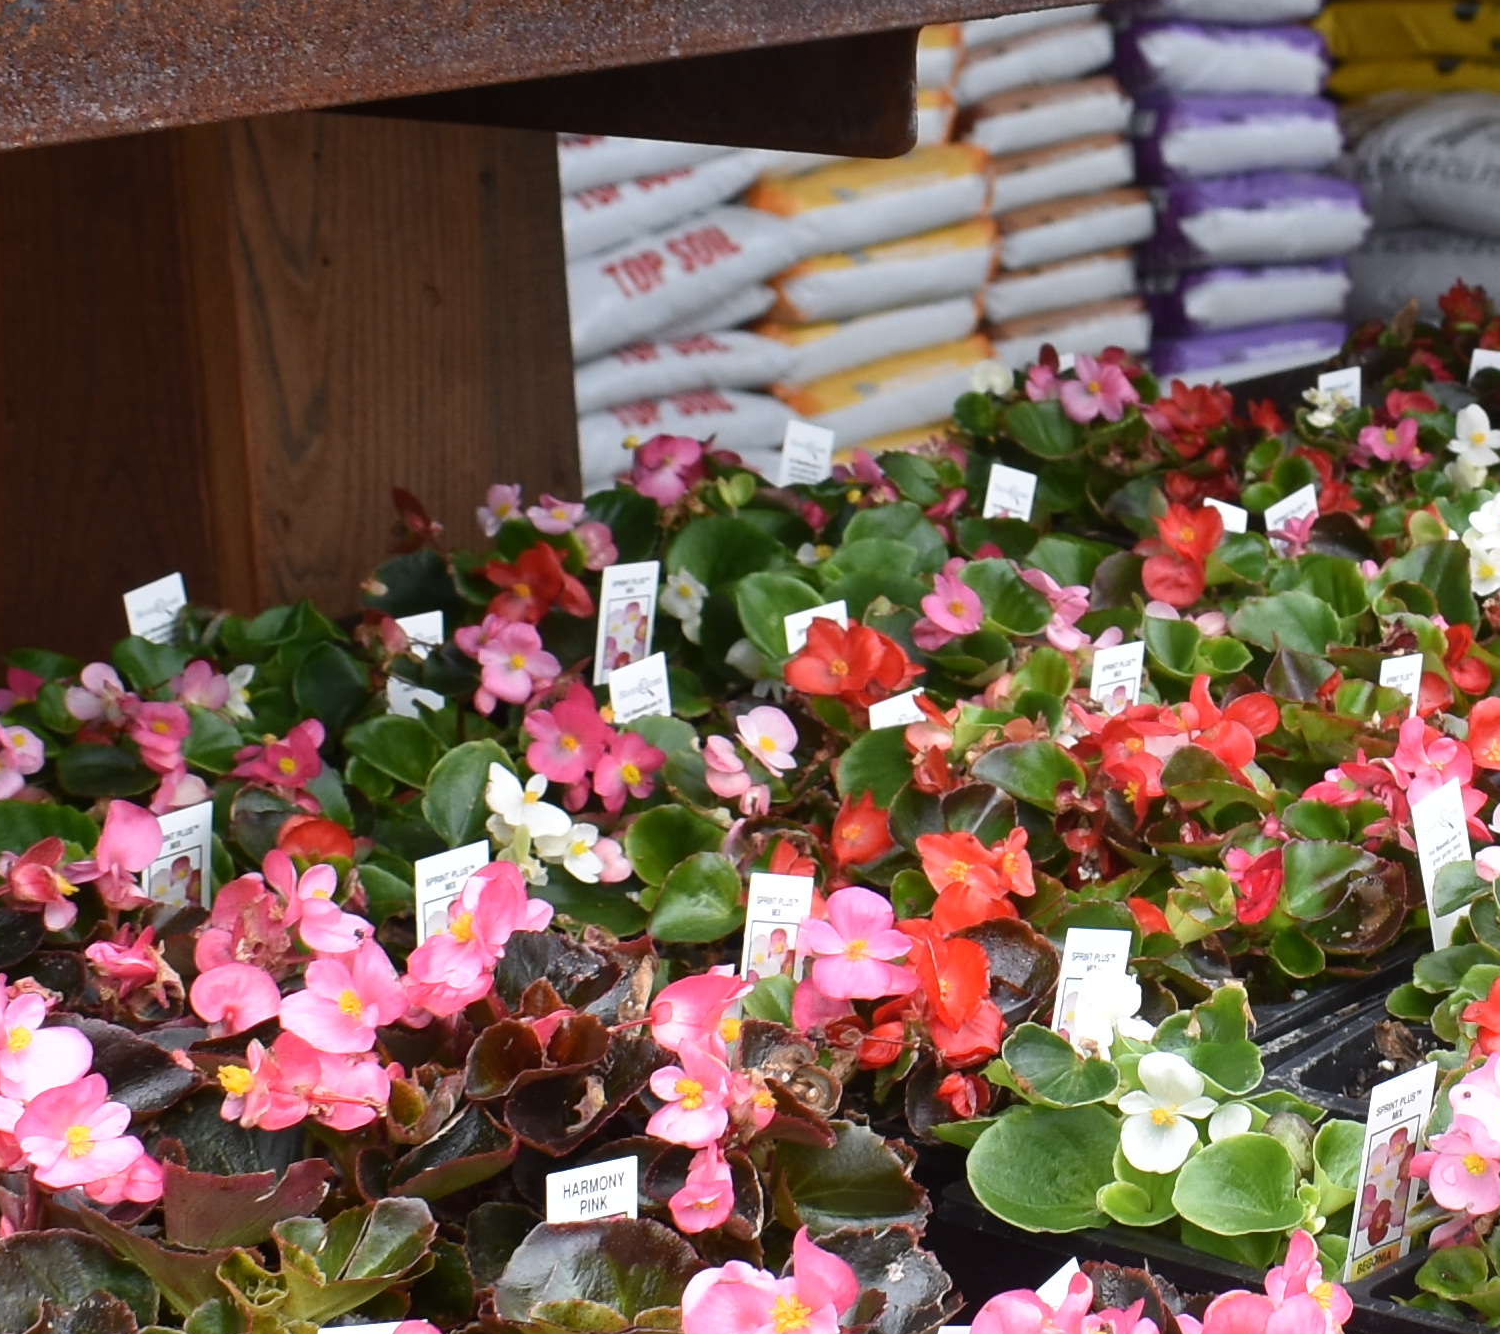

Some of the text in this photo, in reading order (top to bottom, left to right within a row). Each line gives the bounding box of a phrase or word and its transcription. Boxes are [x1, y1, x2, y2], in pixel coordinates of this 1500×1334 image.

[601, 226, 743, 301] TOP SOIL
[1376, 1099, 1399, 1117] SPRINT
[1391, 1108, 1403, 1121] MIX
[562, 1172, 625, 1199] HARMONY
[579, 1195, 608, 1215] PINK
